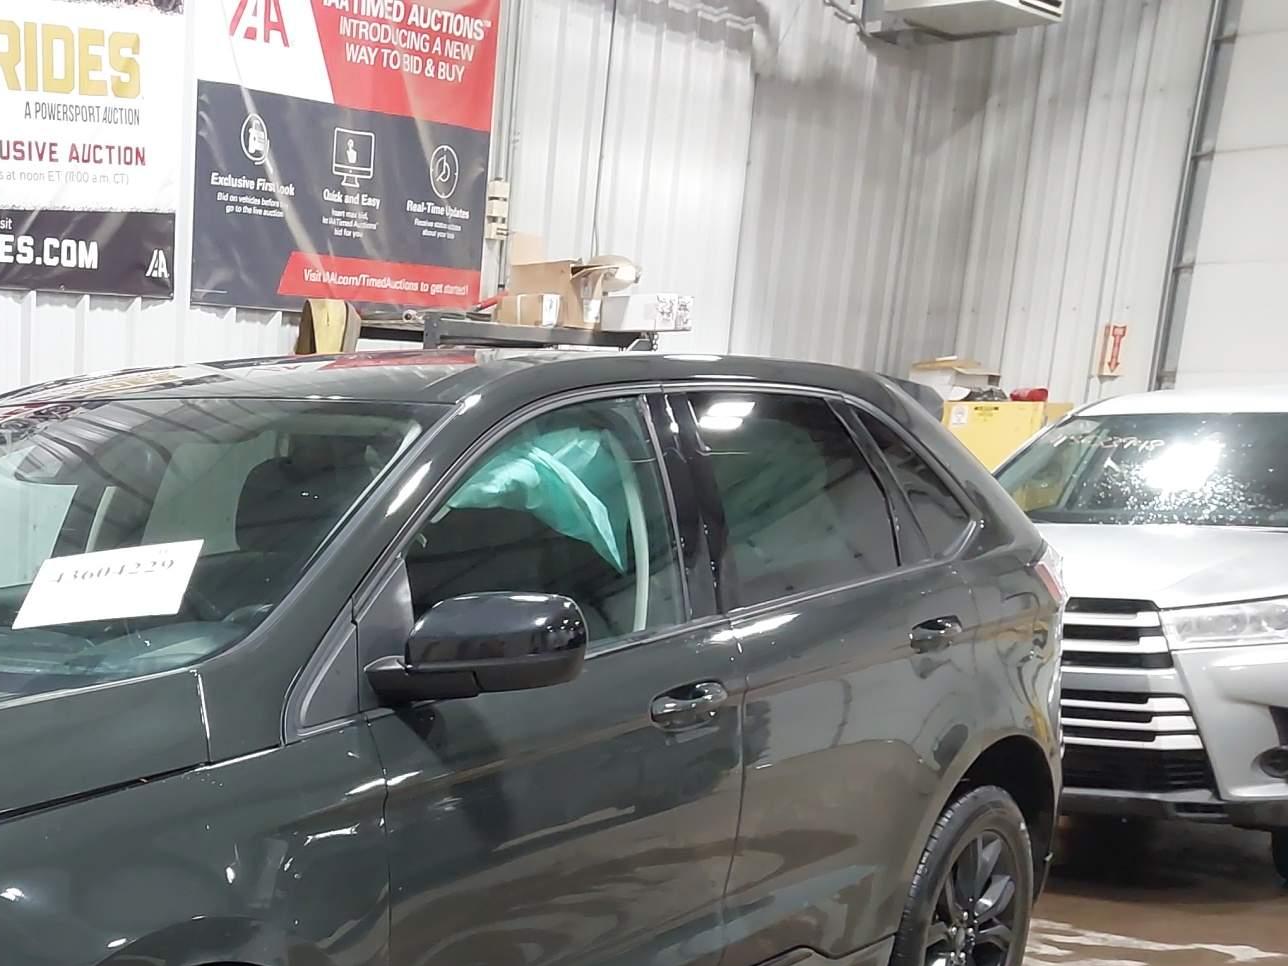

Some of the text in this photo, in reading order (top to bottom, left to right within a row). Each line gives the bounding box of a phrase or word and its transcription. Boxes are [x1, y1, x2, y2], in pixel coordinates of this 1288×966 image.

[339, 15, 475, 61] INTRODUCING A NEW
[345, 42, 465, 82] WAY TO BID & BUY
[24, 101, 140, 126] A POWERSPORT AUCTION
[68, 142, 146, 166] AUCTION
[6, 170, 16, 181] at
[19, 170, 45, 181] noon
[48, 170, 62, 182] ET
[210, 172, 255, 190] Exclusive
[322, 188, 381, 210] Quick and Easy
[406, 199, 445, 216] Real-Time
